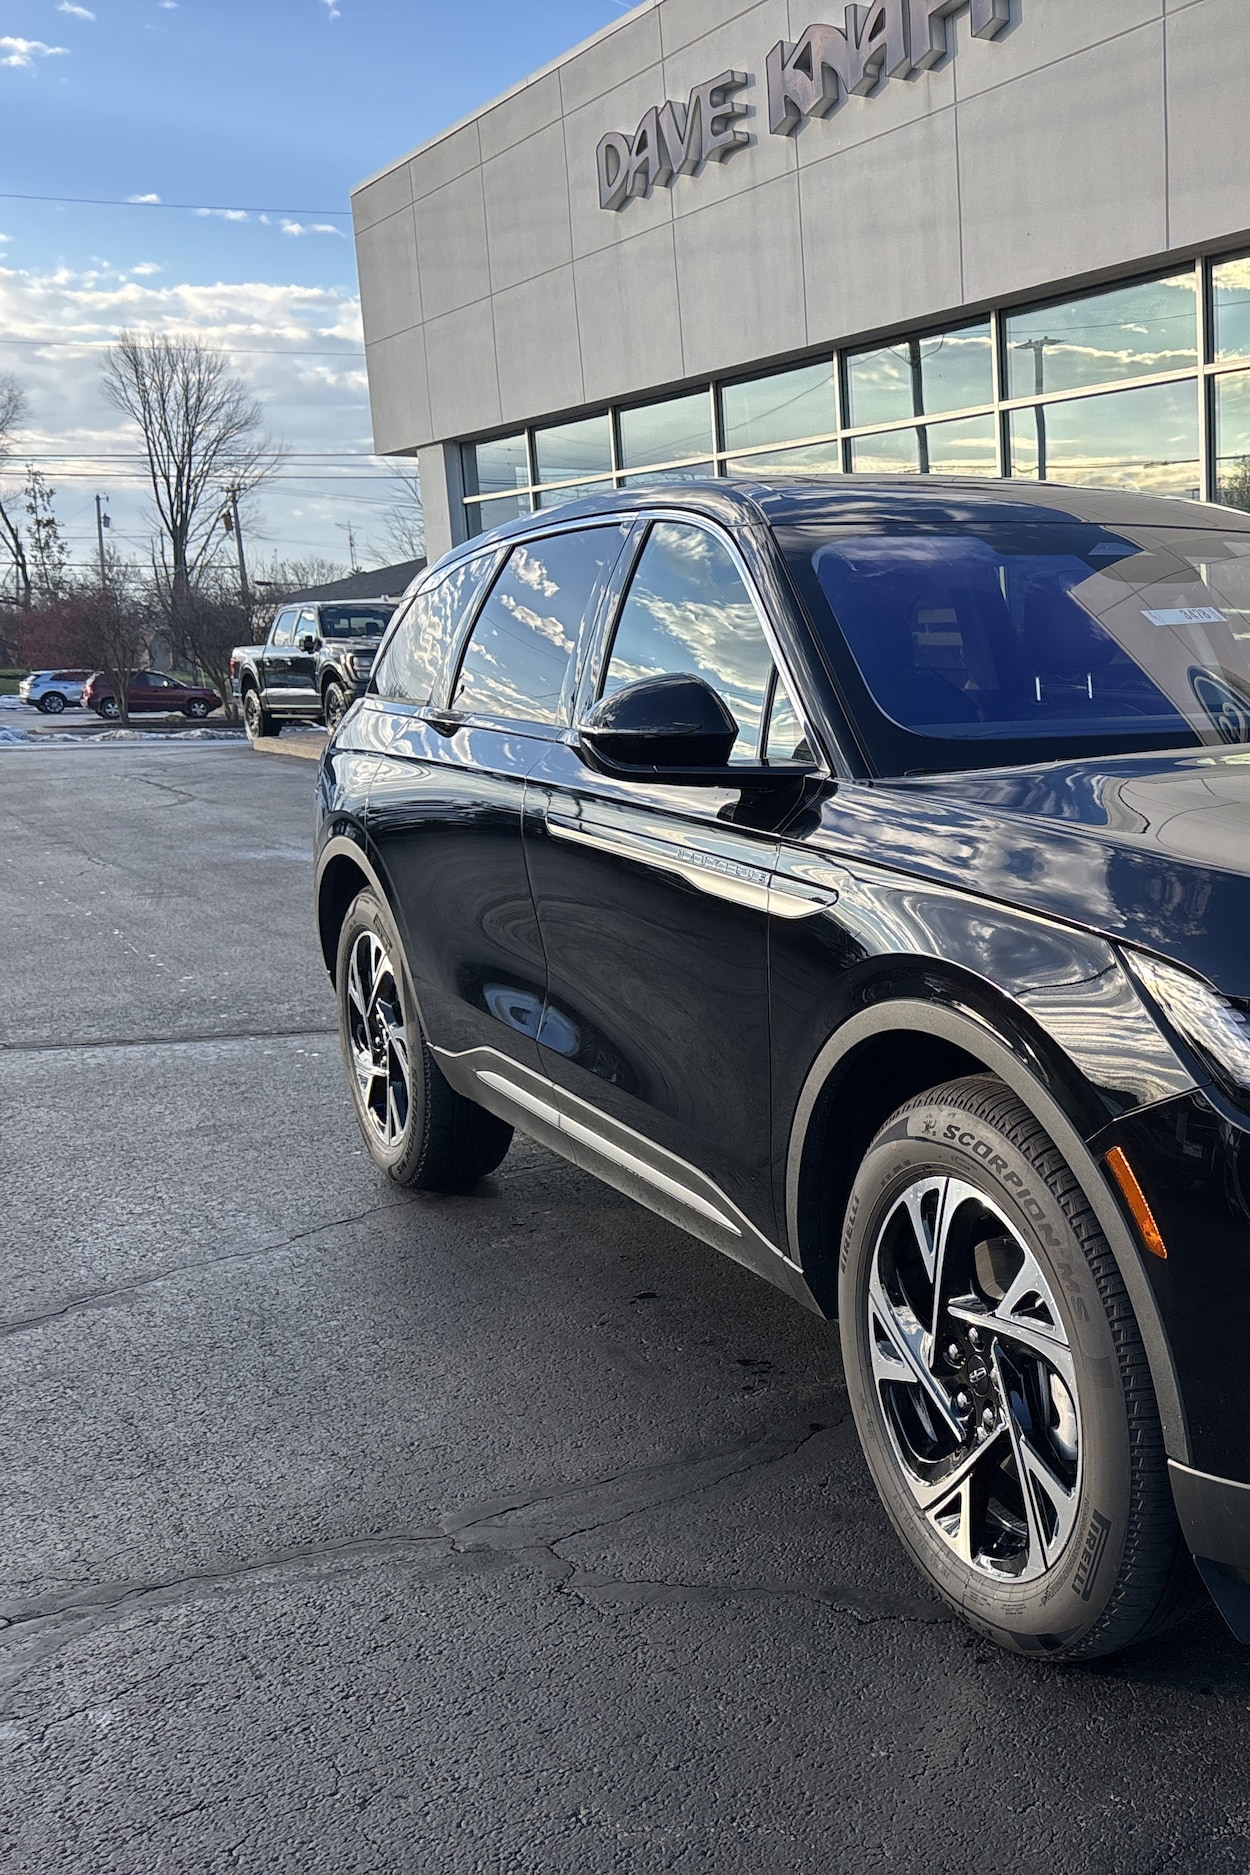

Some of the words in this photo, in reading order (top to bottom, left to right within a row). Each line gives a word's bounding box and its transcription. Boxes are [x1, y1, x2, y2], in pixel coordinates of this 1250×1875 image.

[596, 69, 749, 211] DAVE
[942, 1124, 1061, 1247] SCORPION
[1071, 1508, 1112, 1602] PIRELLI
